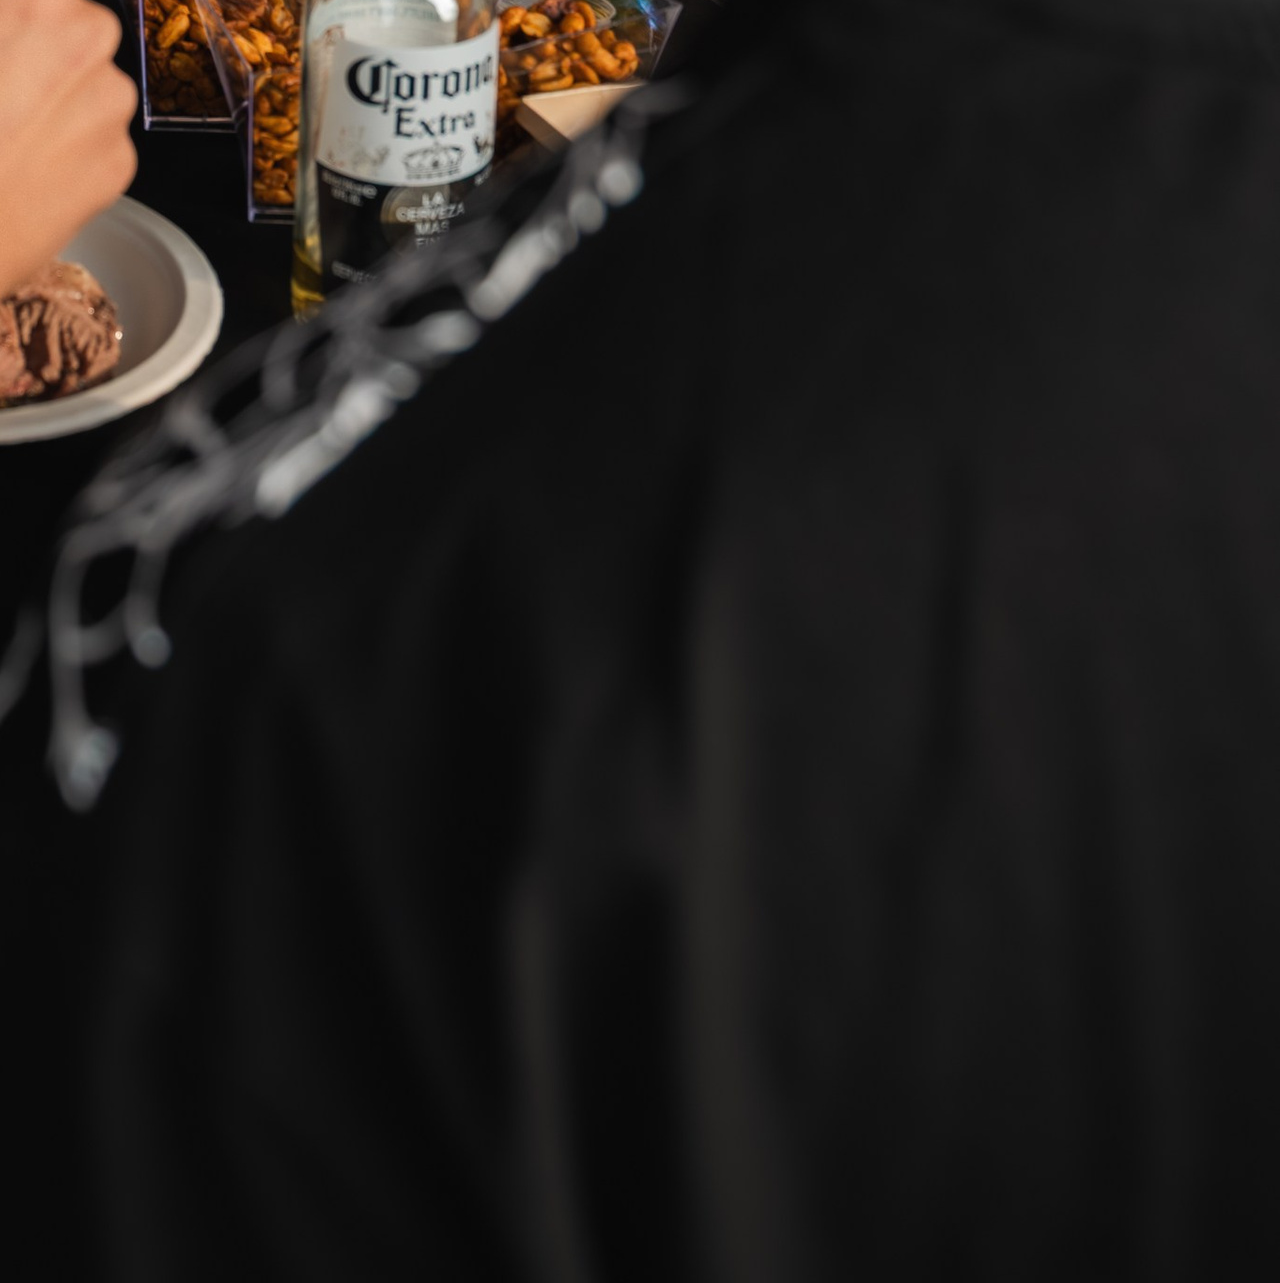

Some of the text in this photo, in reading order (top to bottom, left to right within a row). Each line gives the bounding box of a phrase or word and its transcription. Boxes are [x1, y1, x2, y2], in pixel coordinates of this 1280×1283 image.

[345, 55, 492, 114] Corona
[395, 106, 476, 138] Extra
[421, 191, 445, 206] LA
[396, 202, 466, 222] CERVEZA
